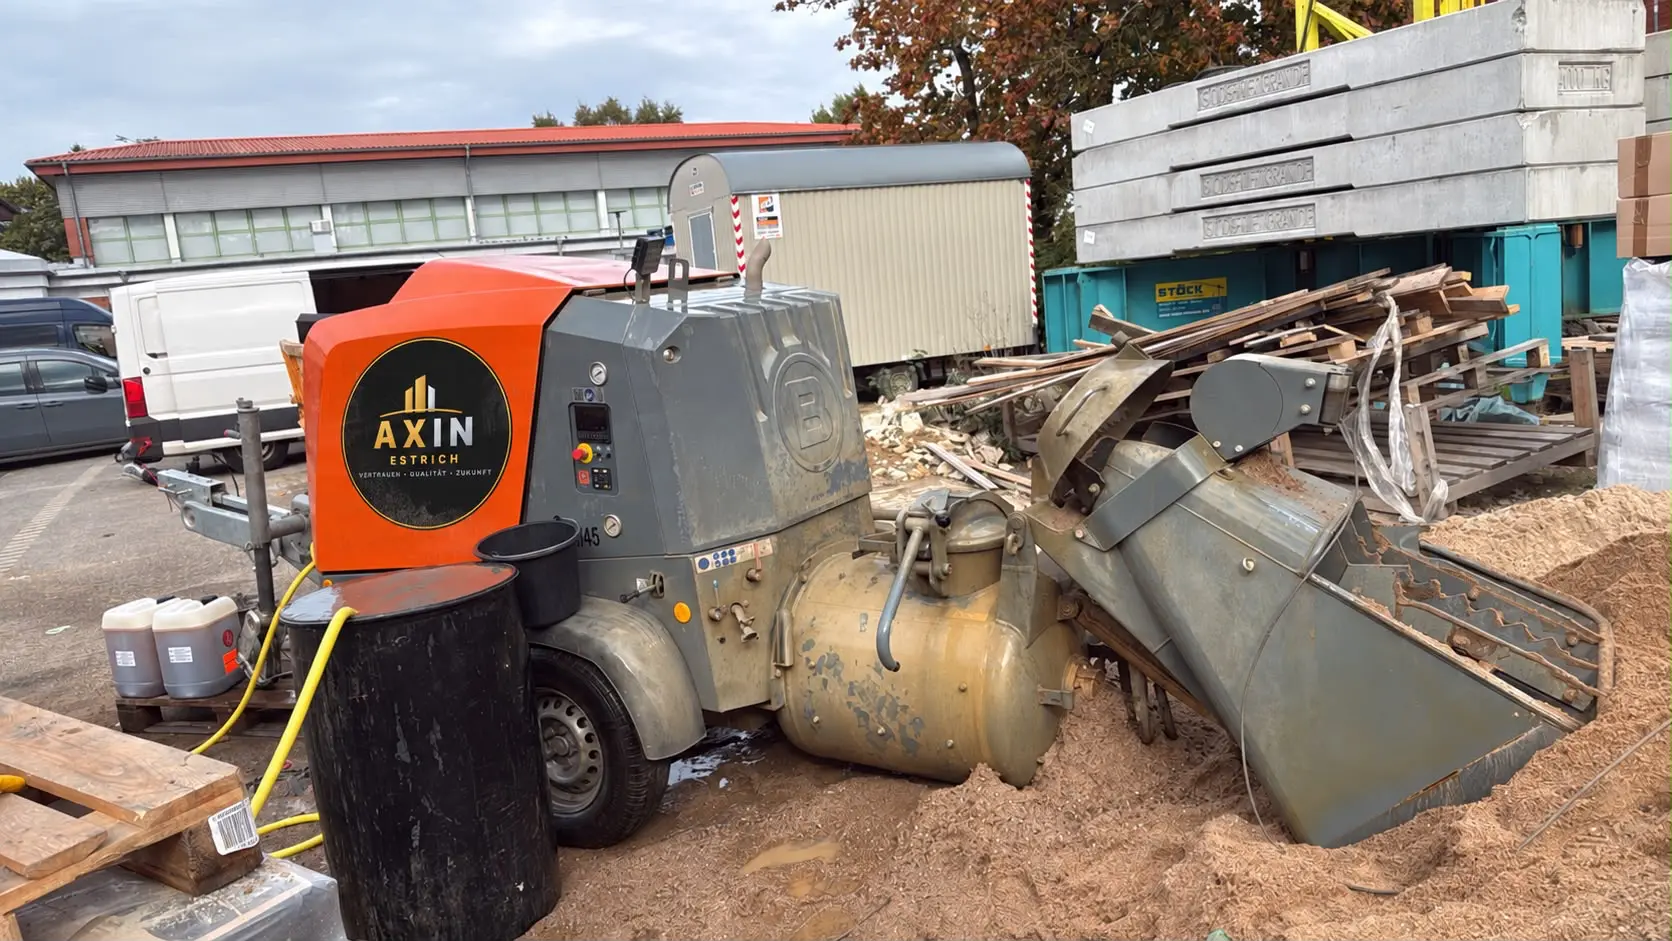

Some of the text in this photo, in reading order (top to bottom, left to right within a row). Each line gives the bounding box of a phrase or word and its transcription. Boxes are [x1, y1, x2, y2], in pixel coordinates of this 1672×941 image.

[1158, 284, 1203, 297] STÖCK
[373, 416, 473, 449] AXIN
[390, 454, 459, 465] ESTRICH
[359, 471, 401, 479] VERTRAUEN
